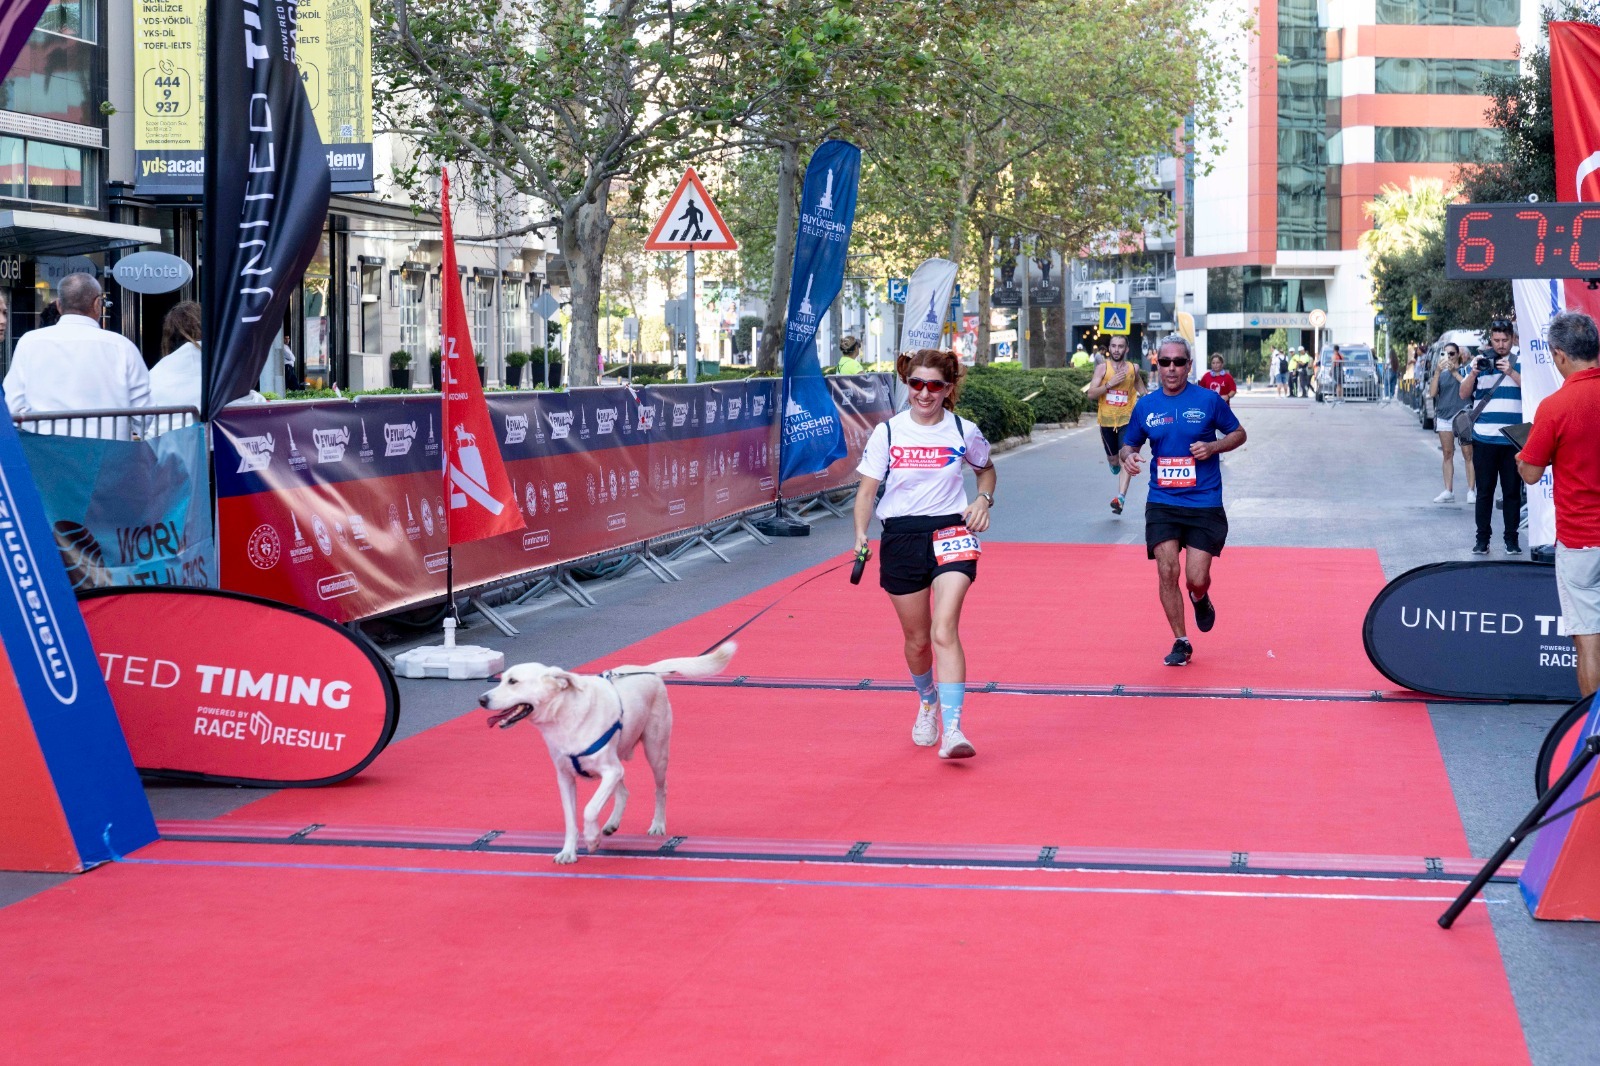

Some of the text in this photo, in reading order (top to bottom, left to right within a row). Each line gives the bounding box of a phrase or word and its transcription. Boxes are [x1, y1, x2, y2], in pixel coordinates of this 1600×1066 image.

[143, 15, 193, 25] YDS-YÖKDİL
[296, 11, 321, 19] ÖKDİL
[143, 28, 176, 37] YKS-DİL
[143, 42, 192, 50] TOEFL-IELTS
[154, 76, 181, 88] 444
[163, 89, 172, 101] 9
[155, 102, 180, 113] 937
[142, 157, 204, 177] ydsacad
[239, 93, 275, 323] UNITED
[0, 254, 22, 280] otel
[119, 263, 182, 281] myhotel
[903, 449, 940, 459] EYLÜL
[1161, 468, 1190, 477] 1770
[117, 521, 188, 564] WORL
[941, 537, 979, 552] 2333
[1401, 606, 1524, 635] UNITED
[100, 653, 352, 710] TED TIMING
[197, 706, 249, 720] POWERED BY
[194, 717, 346, 752] RACE RESULT
